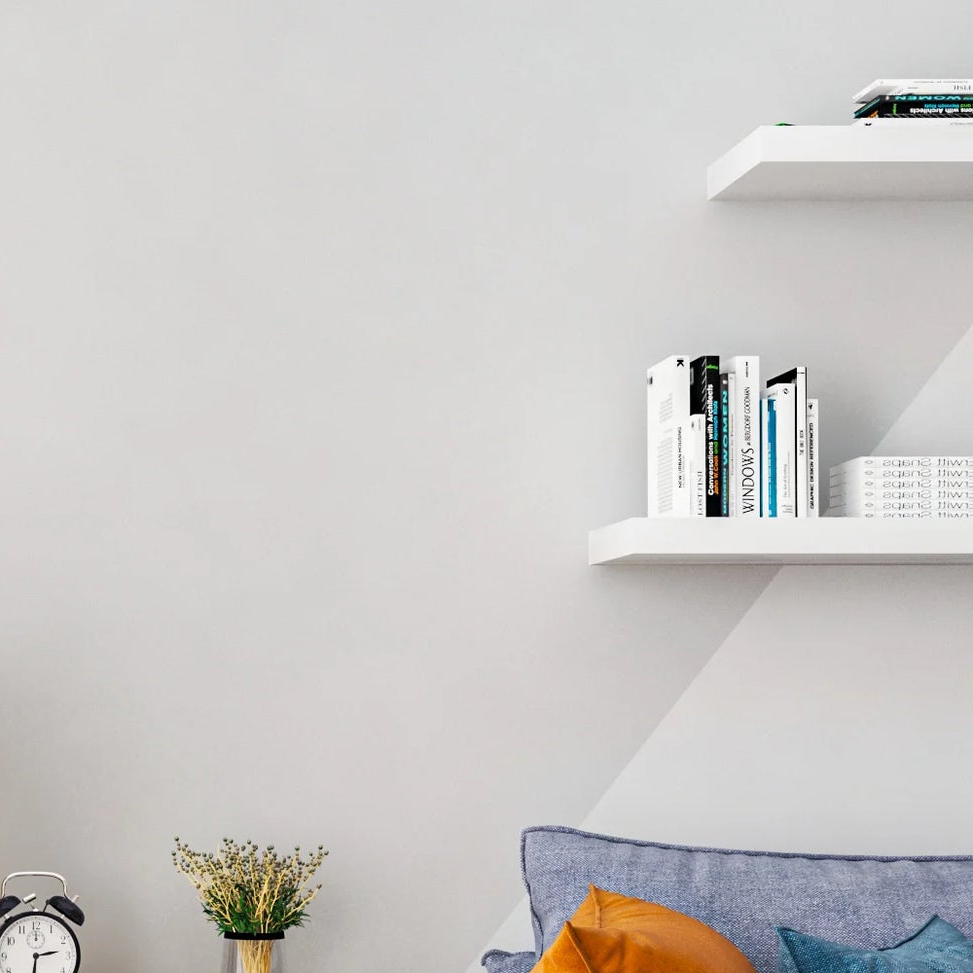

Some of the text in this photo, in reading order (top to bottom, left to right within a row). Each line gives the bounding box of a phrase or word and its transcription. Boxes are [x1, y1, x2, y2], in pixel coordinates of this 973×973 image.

[741, 448, 755, 514] WINDOWS
[32, 921, 41, 930] 12
[49, 925, 53, 933] 1
[18, 926, 26, 934] 11
[7, 937, 16, 945] 10
[61, 936, 66, 945] 2
[1, 953, 7, 961] 9
[65, 951, 71, 960] 3
